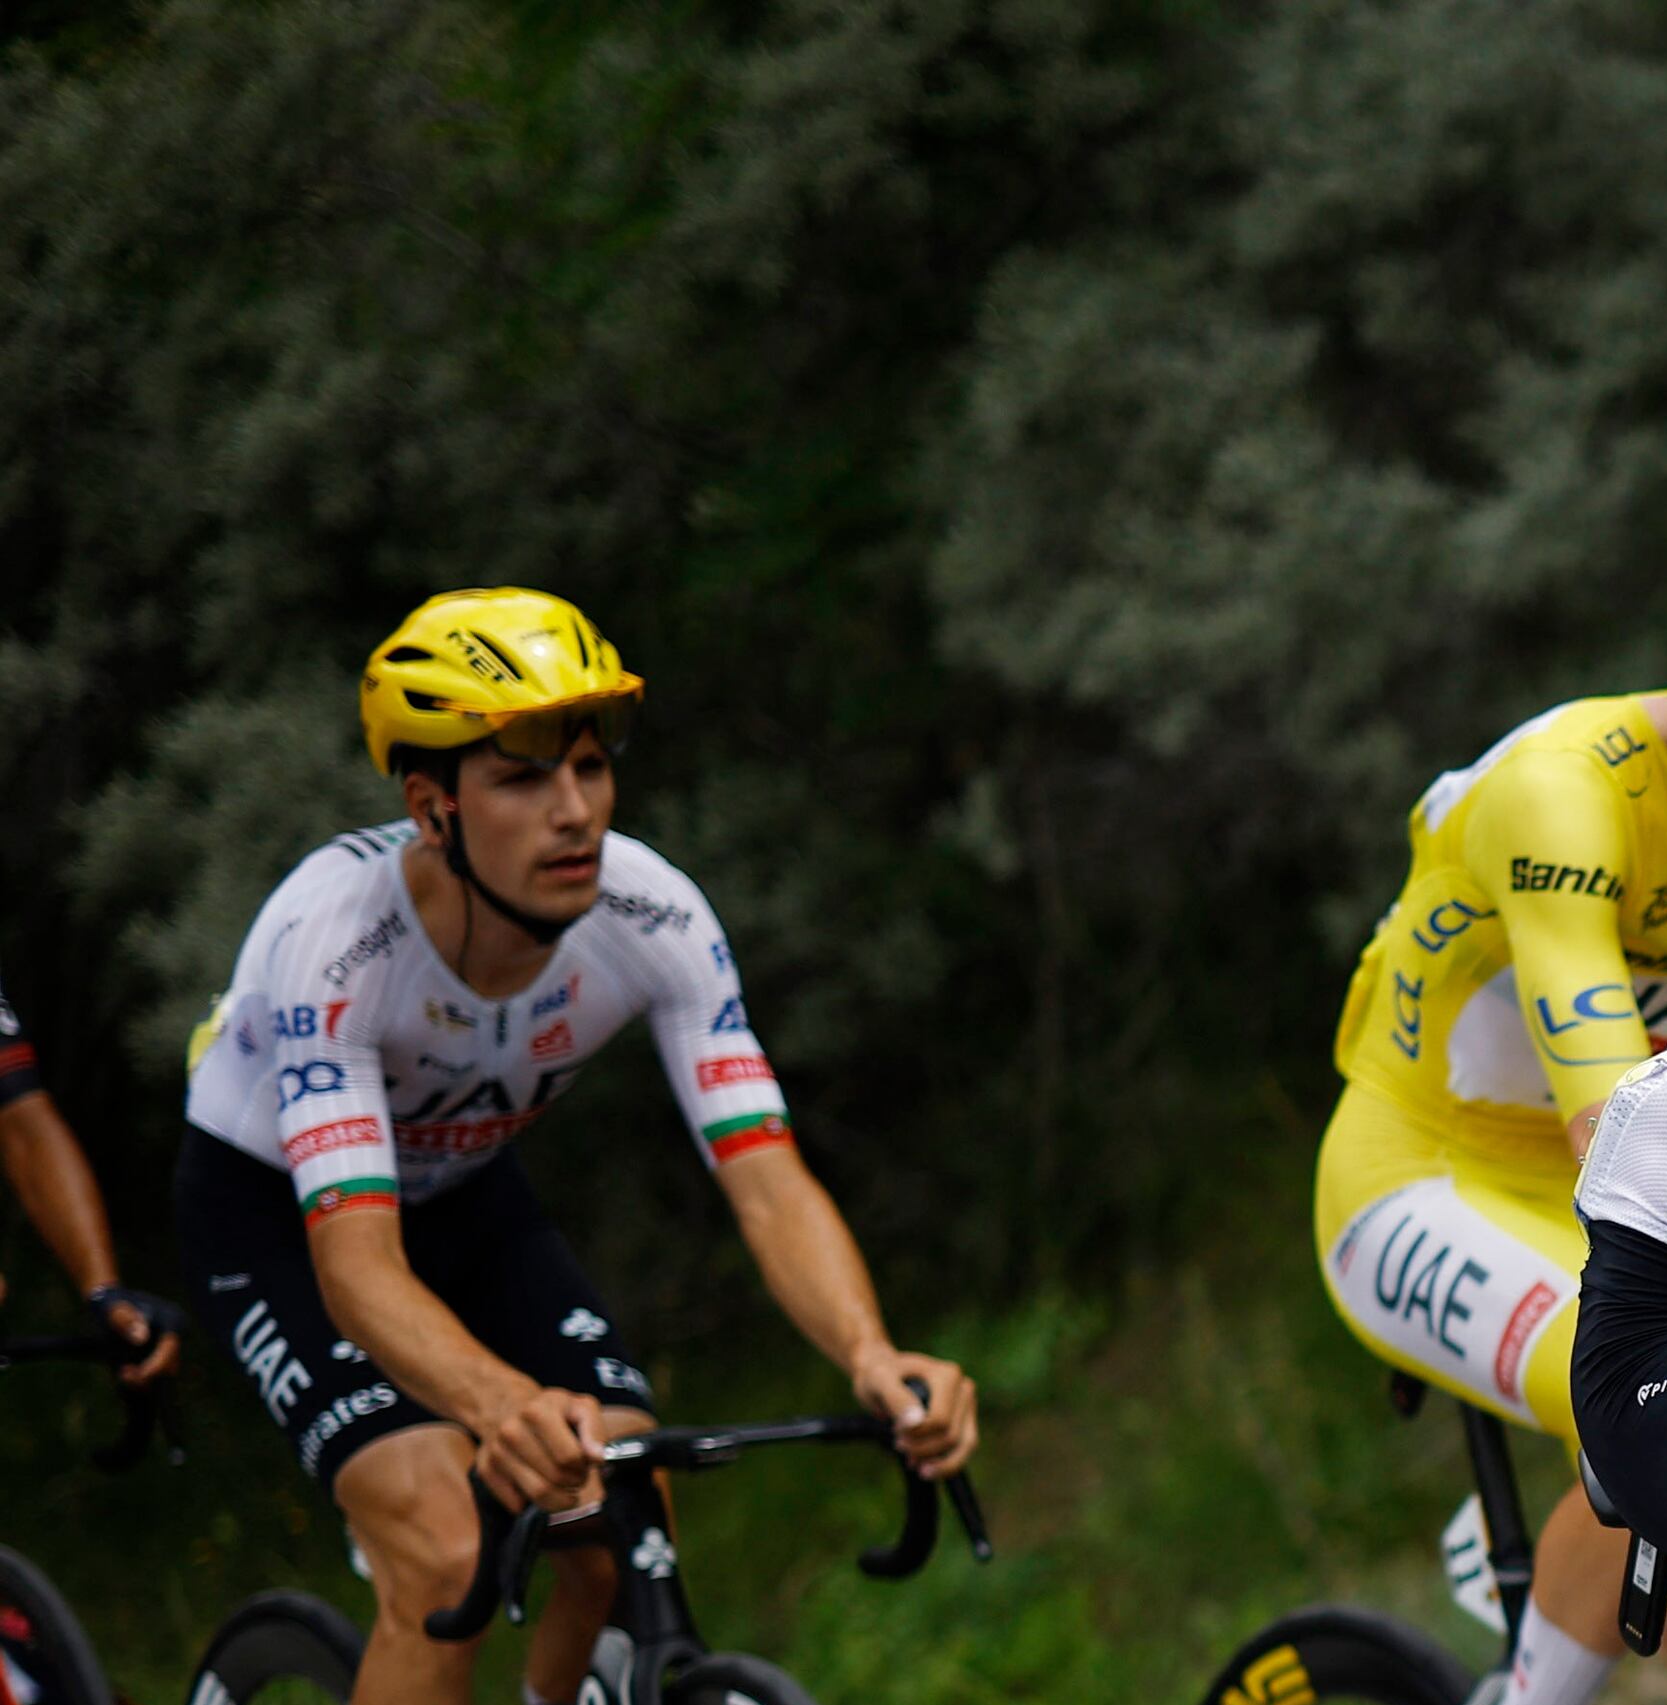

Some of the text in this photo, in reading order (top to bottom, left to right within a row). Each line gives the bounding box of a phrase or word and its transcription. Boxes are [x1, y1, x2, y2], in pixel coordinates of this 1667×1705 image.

[1411, 899, 1499, 955] LCL
[1390, 971, 1424, 1062] LCL
[1536, 983, 1636, 1038] LC
[1375, 1212, 1492, 1361] UAE
[232, 1299, 313, 1428] UAE
